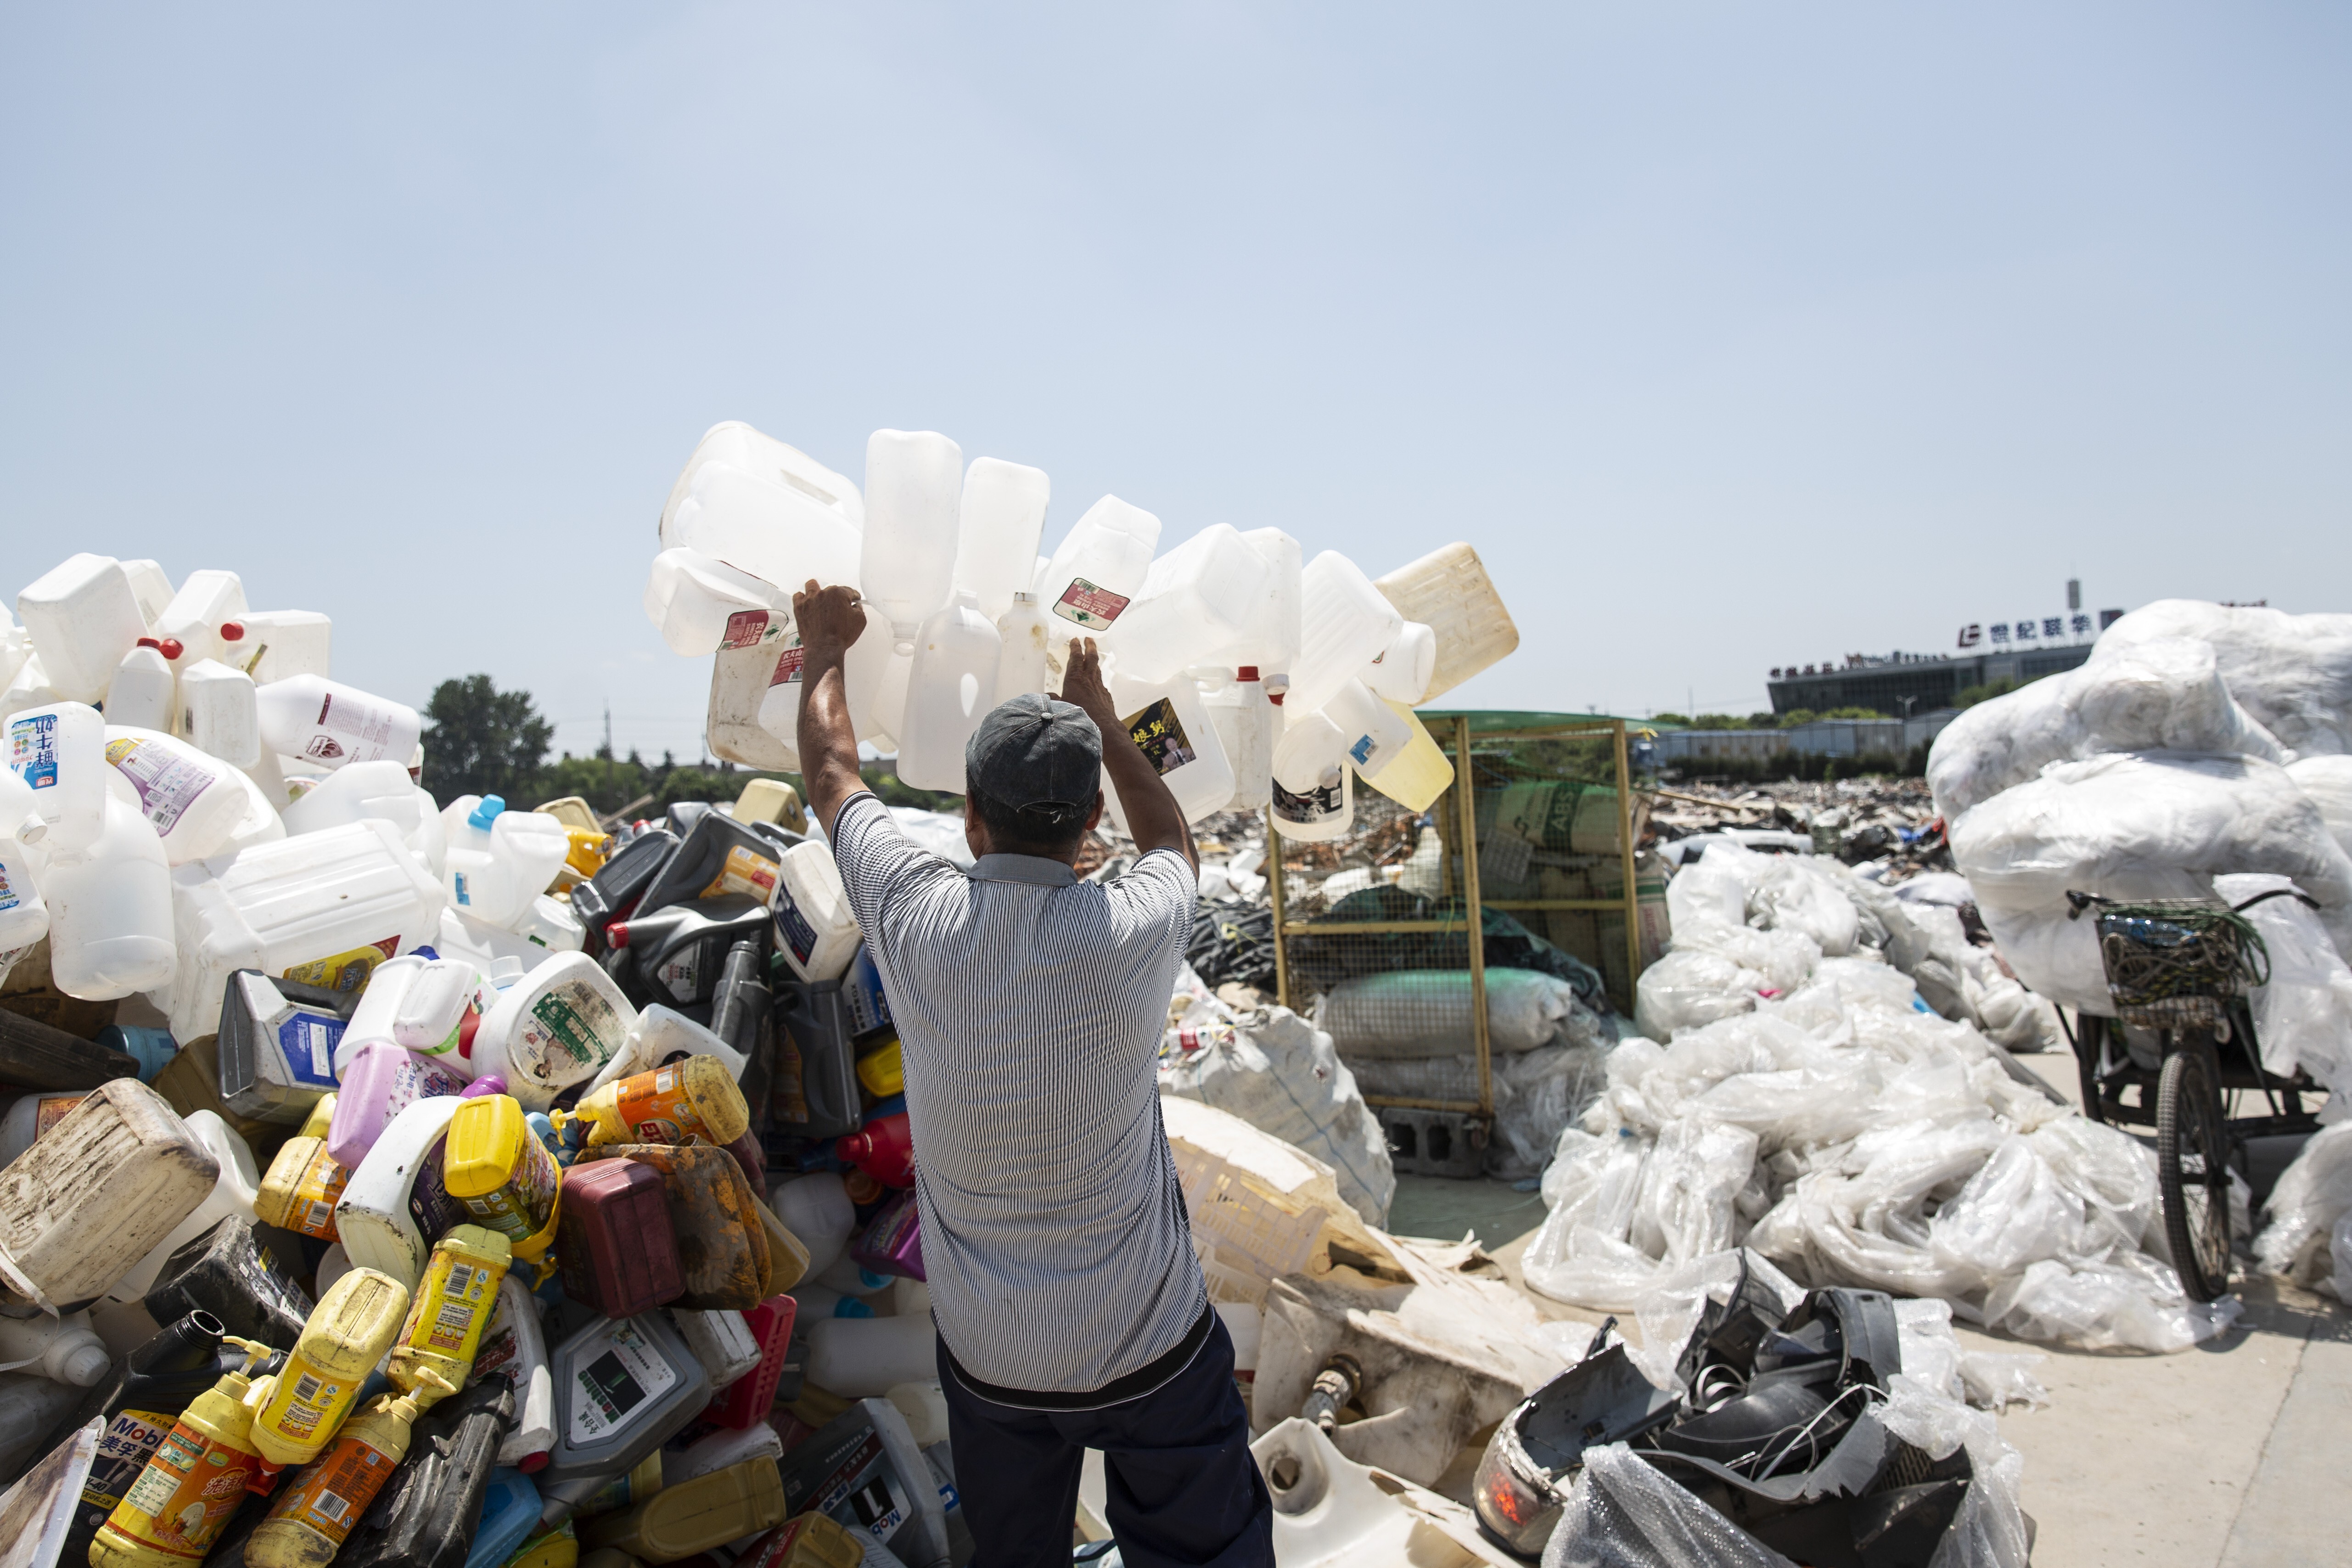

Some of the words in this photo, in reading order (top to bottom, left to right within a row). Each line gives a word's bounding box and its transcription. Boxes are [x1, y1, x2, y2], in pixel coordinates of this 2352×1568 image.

[1071, 597, 1106, 616] 农夫山泉
[1076, 595, 1092, 605] SPRING
[1989, 614, 2091, 643] 世纪联华
[783, 649, 804, 659] 农夫山
[35, 716, 53, 767] 鲜牛奶
[38, 778, 53, 786] 光明
[113, 1417, 163, 1448] Mobi
[578, 1411, 600, 1435] 全合成
[863, 1486, 883, 1517] 1
[871, 1509, 902, 1536] Mob
